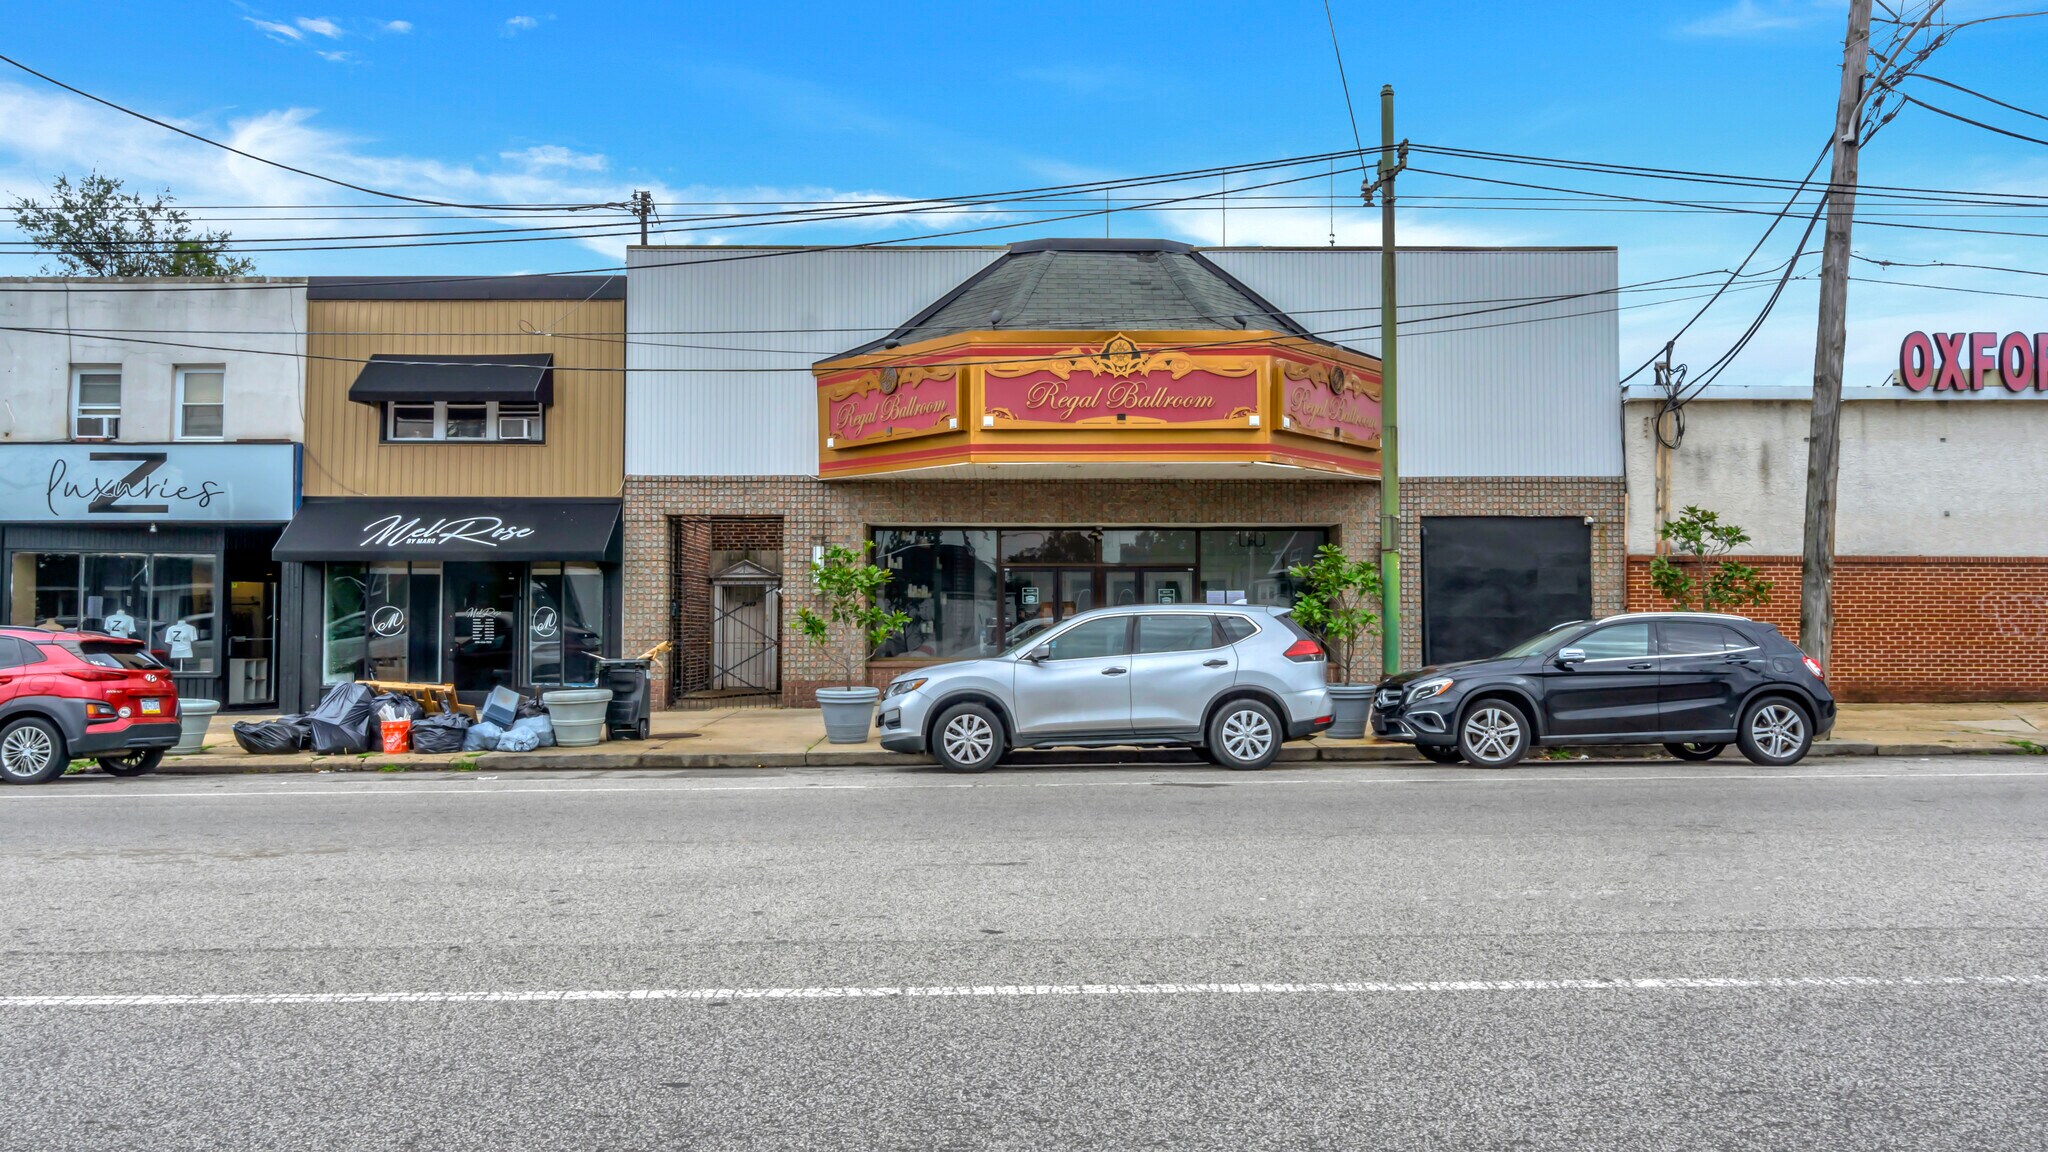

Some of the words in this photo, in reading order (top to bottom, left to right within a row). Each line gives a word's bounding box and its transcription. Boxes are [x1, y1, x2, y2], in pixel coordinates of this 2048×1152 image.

[837, 401, 880, 437] Regal
[881, 393, 947, 422] Ballroom
[1026, 380, 1103, 420] Regal
[1106, 380, 1216, 409] Ballroom
[1291, 386, 1328, 427] Regal
[1328, 396, 1377, 430] Ballroom
[47, 459, 225, 516] luxuries
[88, 452, 169, 513] Z
[112, 620, 122, 632] Z
[173, 630, 182, 642] Z
